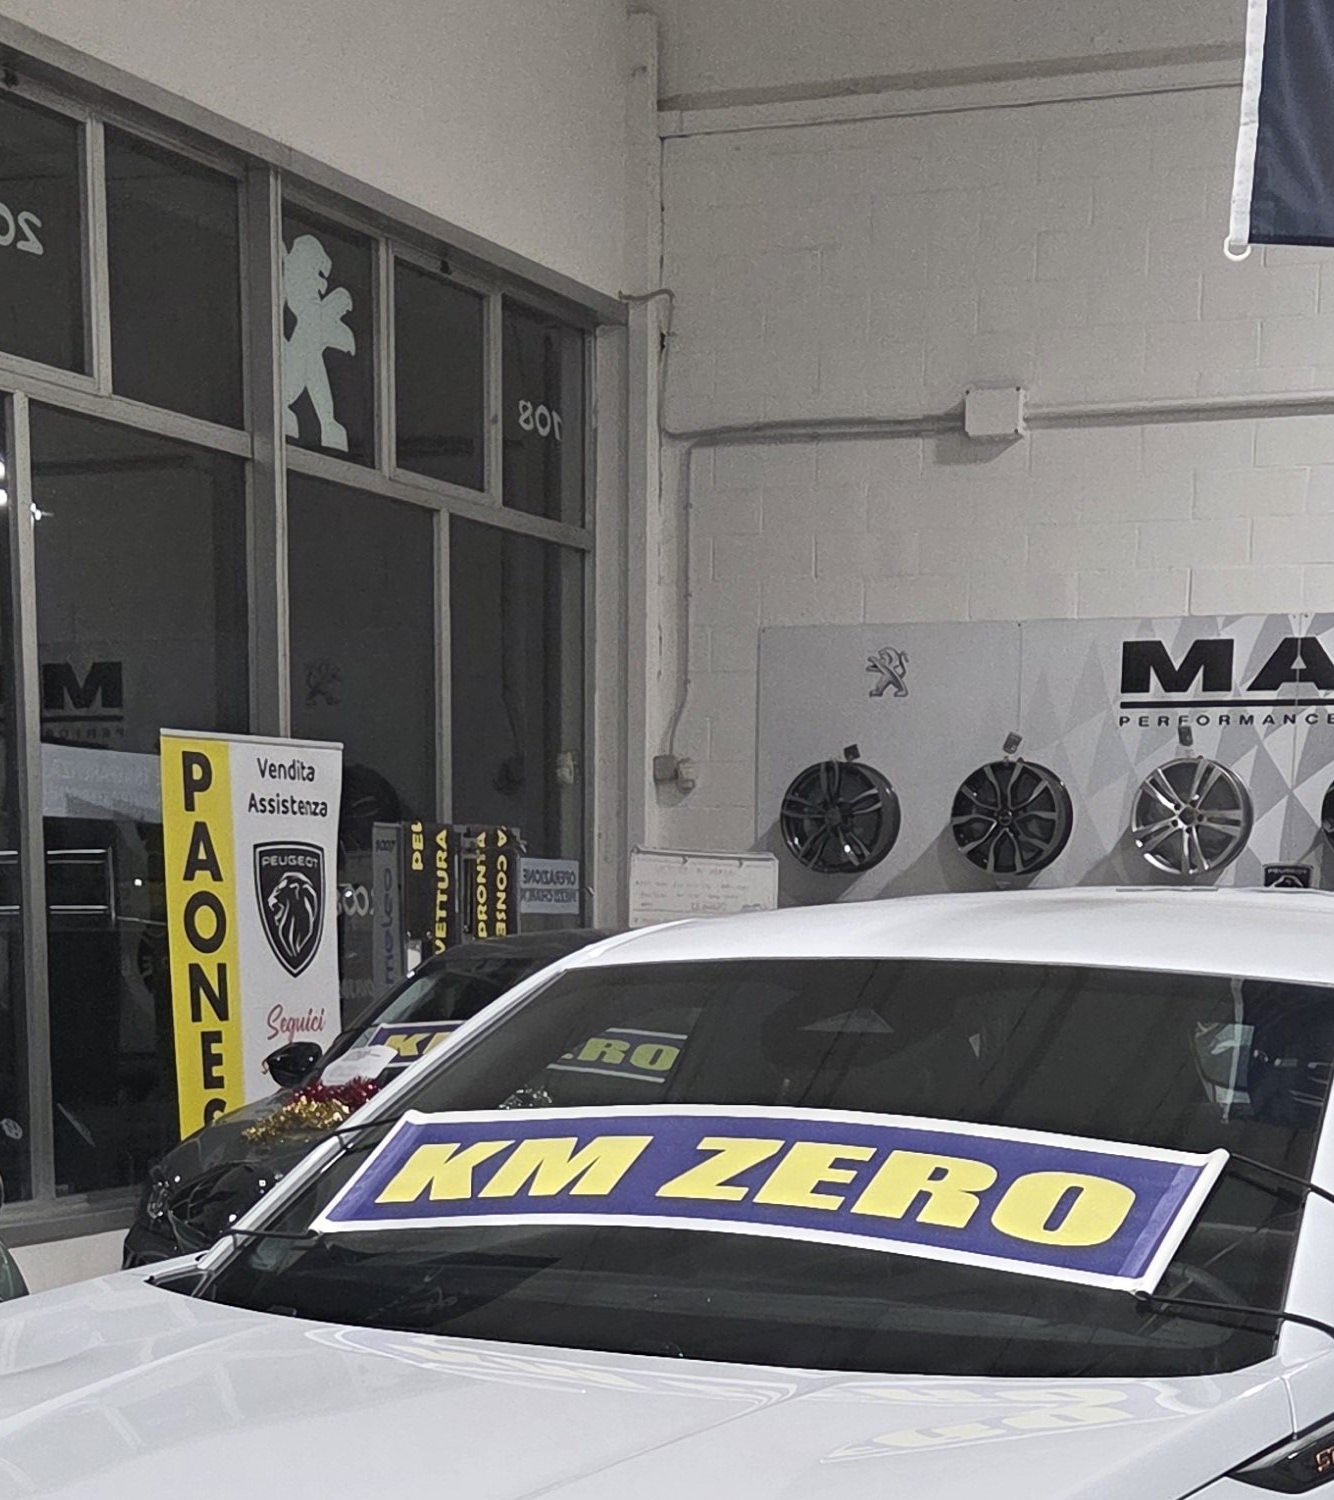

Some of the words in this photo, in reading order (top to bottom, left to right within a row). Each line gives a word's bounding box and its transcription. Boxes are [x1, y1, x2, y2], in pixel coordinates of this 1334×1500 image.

[257, 758, 316, 782] Vendita
[247, 792, 329, 818] Assistenza
[262, 855, 320, 869] PEUGEOT
[434, 829, 449, 955] VETTURA
[475, 831, 488, 938] PRONTA
[267, 1004, 326, 1045] Seguici
[376, 1135, 652, 1203] KM
[656, 1136, 1136, 1247] ZERO
